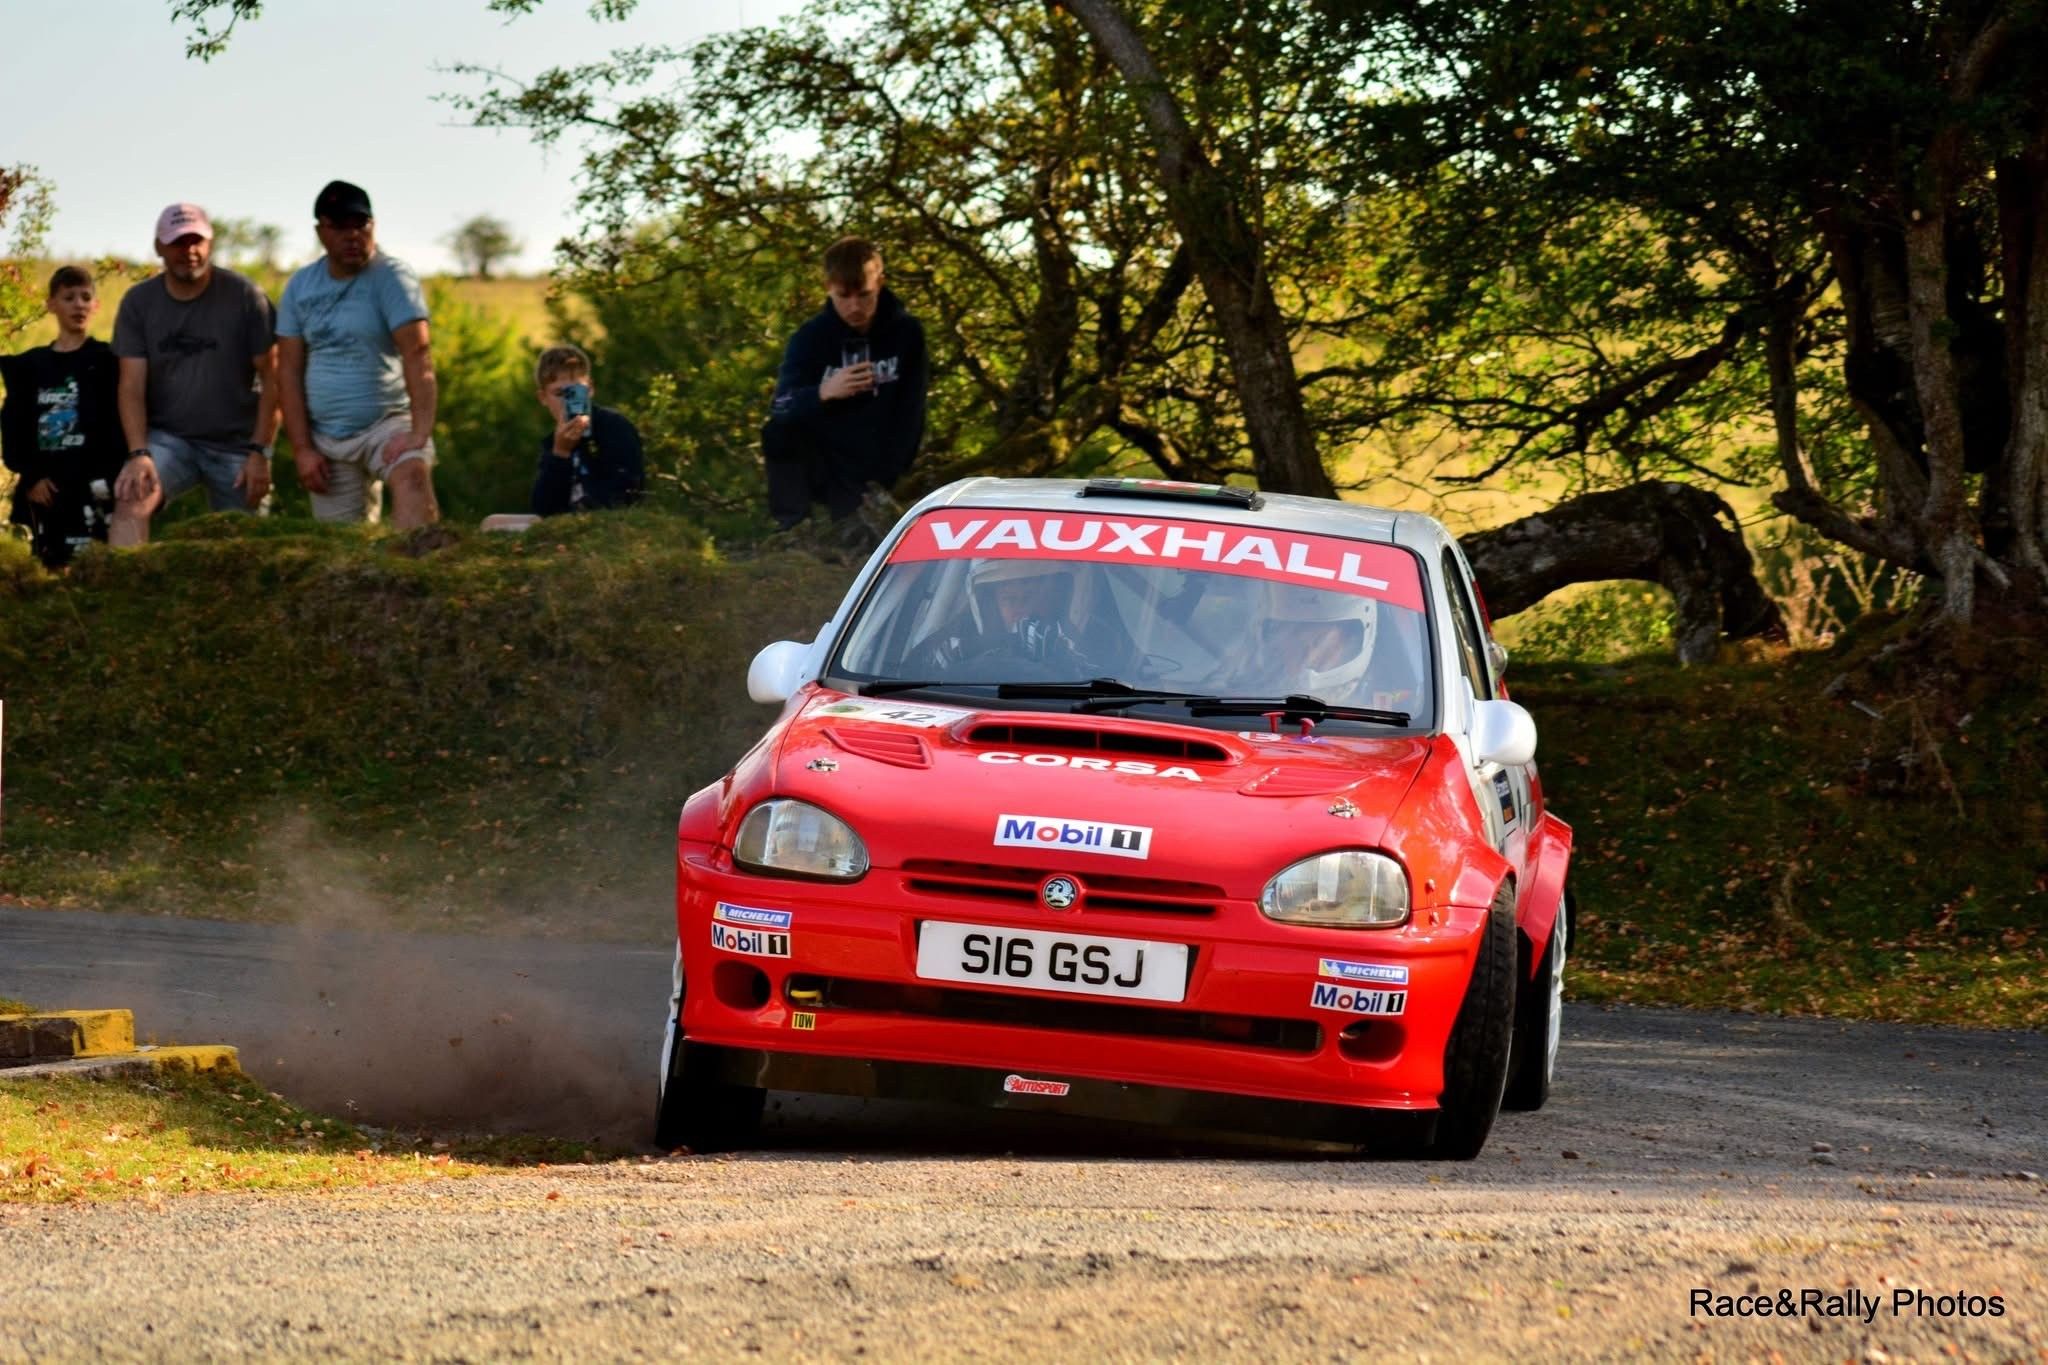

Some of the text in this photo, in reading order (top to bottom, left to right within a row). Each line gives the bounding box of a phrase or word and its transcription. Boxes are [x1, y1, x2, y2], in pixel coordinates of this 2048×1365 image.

[929, 518, 1389, 591] VAUXHALL
[881, 711, 937, 723] 42
[977, 751, 1203, 782] CORSA
[1003, 819, 1104, 847] Mobil
[727, 908, 786, 923] MICHELIN
[713, 924, 786, 955] Mobil 1
[961, 933, 1145, 988] S16 GSJ
[1343, 965, 1405, 979] MICHELIN
[1314, 984, 1403, 1013] Mobil 1
[794, 1013, 815, 1029] TOW
[1010, 1079, 1069, 1095] AUTOSPORT
